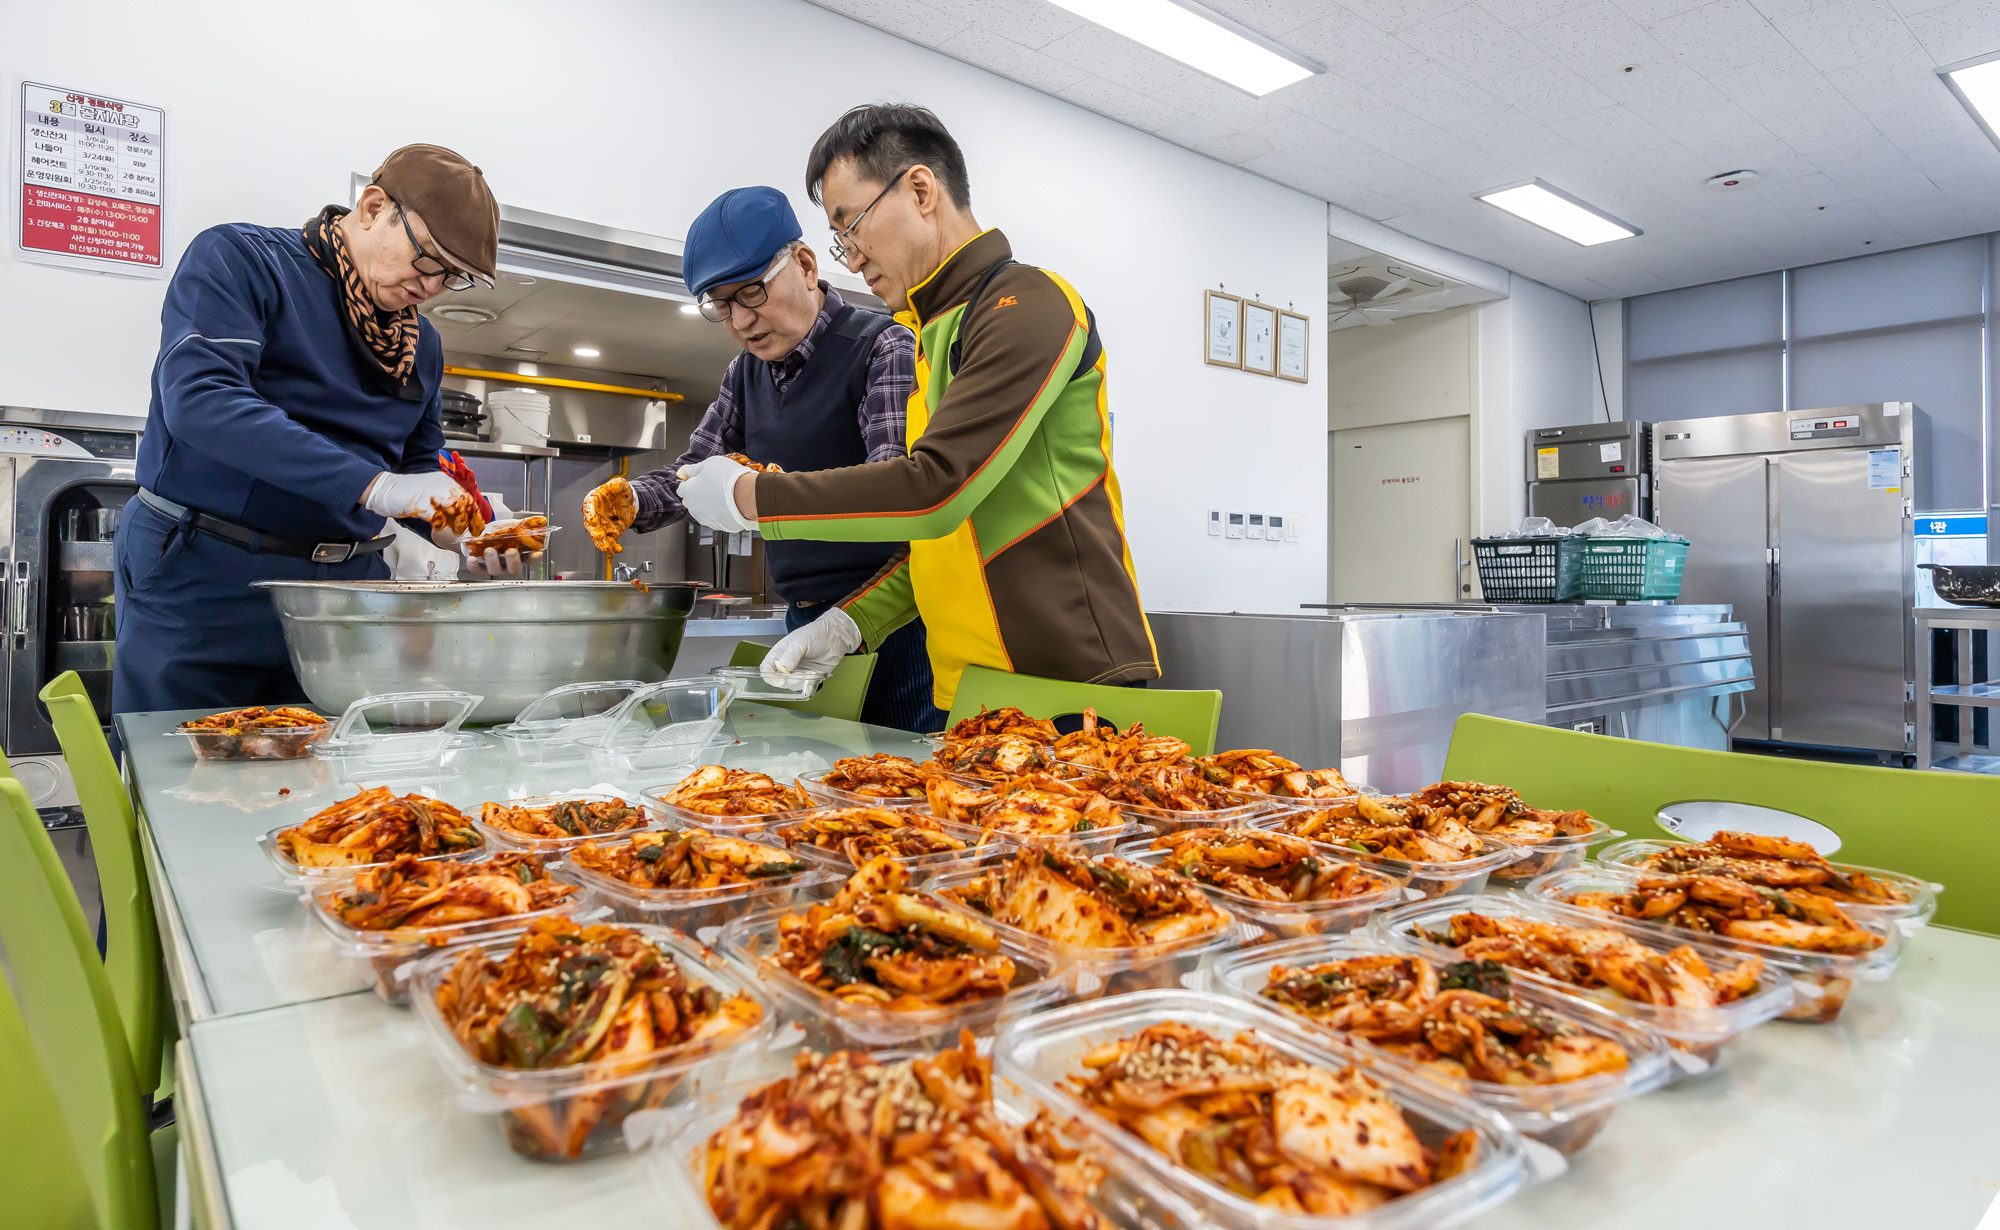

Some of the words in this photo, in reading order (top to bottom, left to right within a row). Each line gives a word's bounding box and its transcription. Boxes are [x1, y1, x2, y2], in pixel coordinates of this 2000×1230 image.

[39, 115, 60, 127] 내용
[80, 105, 140, 128] 공지사항
[31, 127, 67, 141] 생신잔치
[84, 124, 105, 136] 일시
[85, 136, 109, 144] 3/6(금)
[129, 132, 150, 144] 장소
[35, 142, 63, 154] 나들이
[31, 157, 68, 169] 헤어컷트
[83, 152, 115, 163] 3/24(화)
[26, 170, 72, 184] 운영위원회
[83, 177, 111, 187] 3/25(수)
